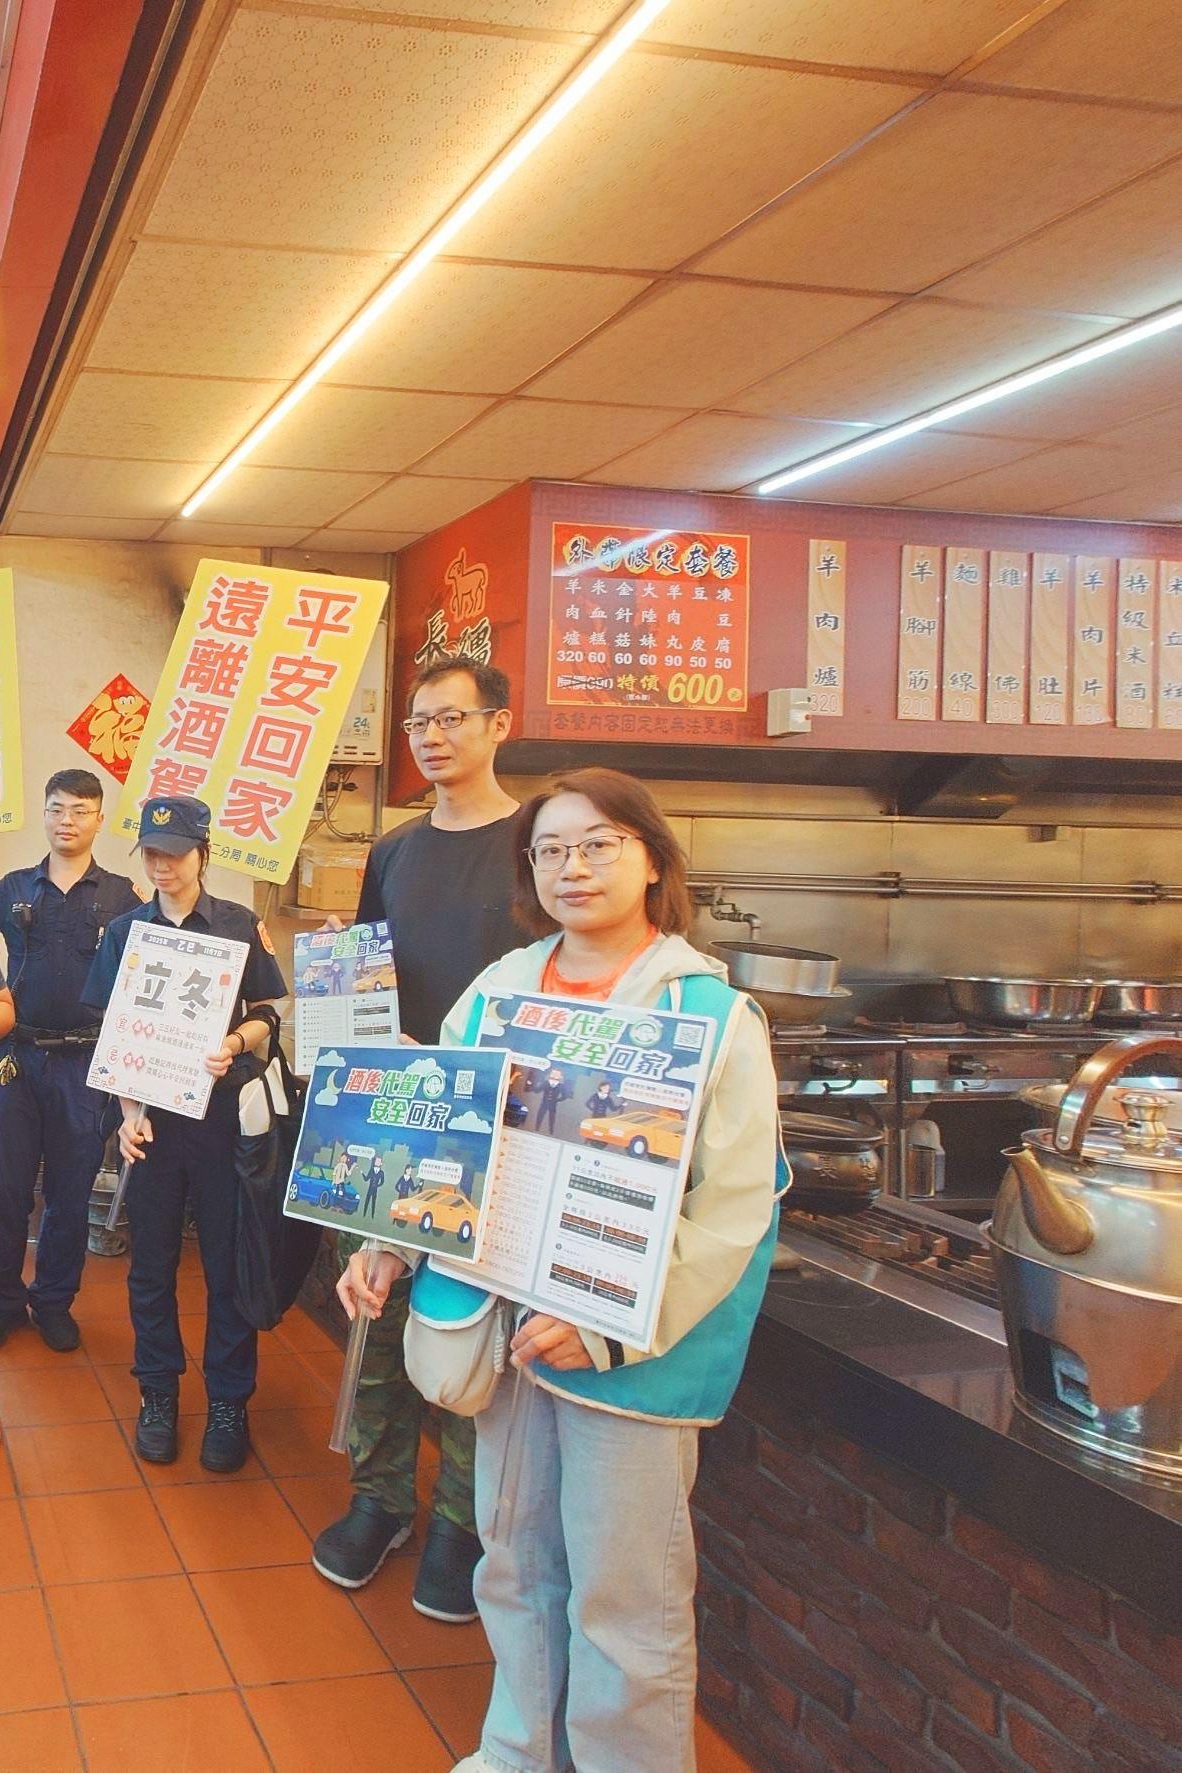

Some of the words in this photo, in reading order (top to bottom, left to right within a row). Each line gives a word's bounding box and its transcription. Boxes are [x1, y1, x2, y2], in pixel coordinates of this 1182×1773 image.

[561, 577, 583, 647] 羊肉爐
[614, 581, 634, 648] 金針菇
[638, 582, 659, 650] 大陸妹
[664, 583, 684, 651] 羊肉丸
[813, 555, 840, 688] 羊肉爐
[1080, 570, 1104, 698] 羊肉片
[556, 650, 583, 663] 320
[588, 651, 607, 664] 60
[614, 652, 633, 665] 60
[639, 653, 658, 666] 60
[664, 654, 683, 667] 90
[689, 655, 708, 668] 50
[714, 656, 732, 670] 50
[616, 674, 661, 693] 特價
[668, 673, 724, 705] 600
[218, 588, 358, 842] 平安回家
[133, 961, 212, 1021] 立冬
[517, 1004, 626, 1041] 酒後代駕
[343, 1067, 422, 1097] 酒後代駕
[551, 1038, 668, 1079] 安全回家
[368, 1098, 451, 1132] 安全回家
